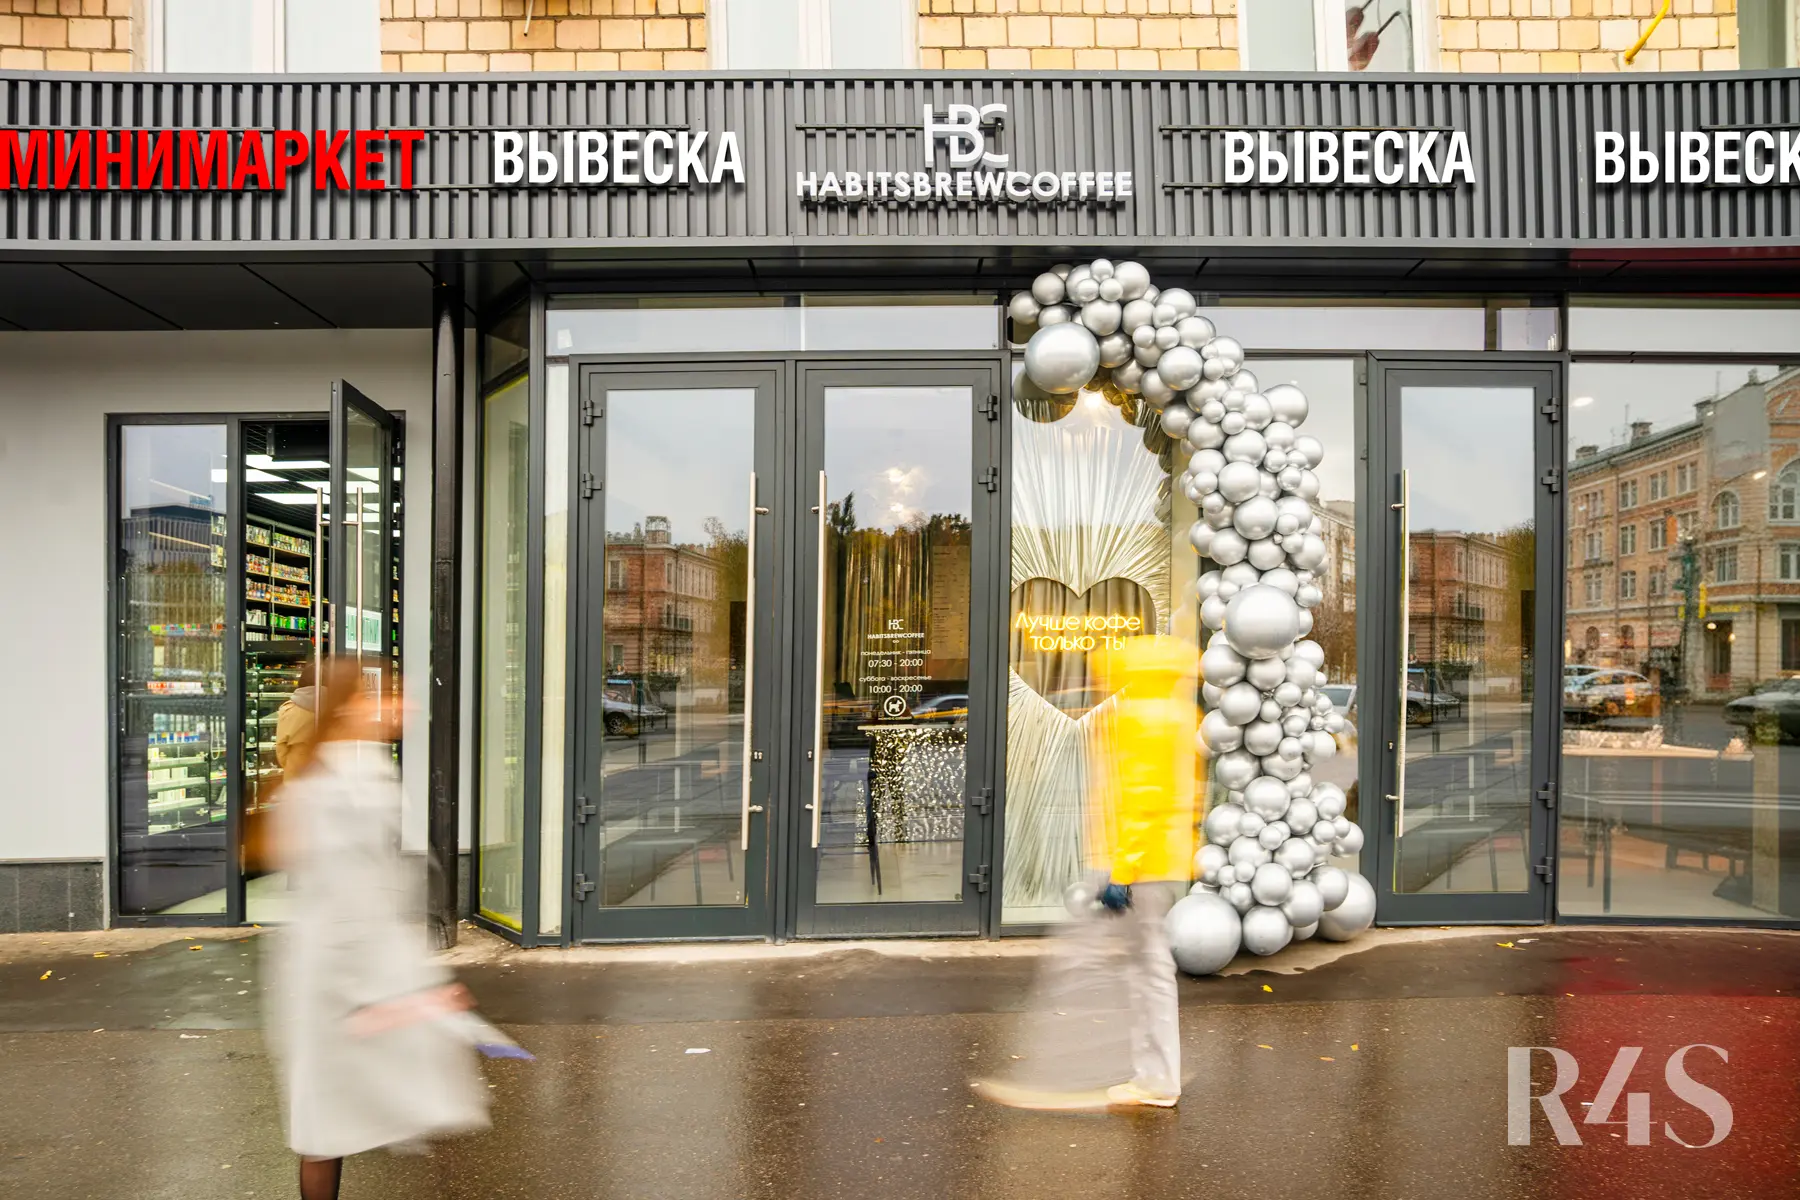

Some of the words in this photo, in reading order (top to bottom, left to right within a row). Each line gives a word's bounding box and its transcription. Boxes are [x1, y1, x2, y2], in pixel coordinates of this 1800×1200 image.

[923, 103, 1009, 168] HBC
[0, 129, 425, 191] МИНИМАРКЕТ
[493, 130, 746, 185] ВЫВЕСКА
[1224, 130, 1476, 184] ВЫВЕСКА
[796, 171, 1133, 201] HABITSBREWCOFFEE
[1015, 612, 1081, 633] Лучше
[1084, 613, 1141, 632] кофе
[868, 659, 892, 668] 07:30
[899, 658, 923, 667] 20:00
[869, 685, 892, 693] 10:00
[898, 684, 923, 693] 20:00
